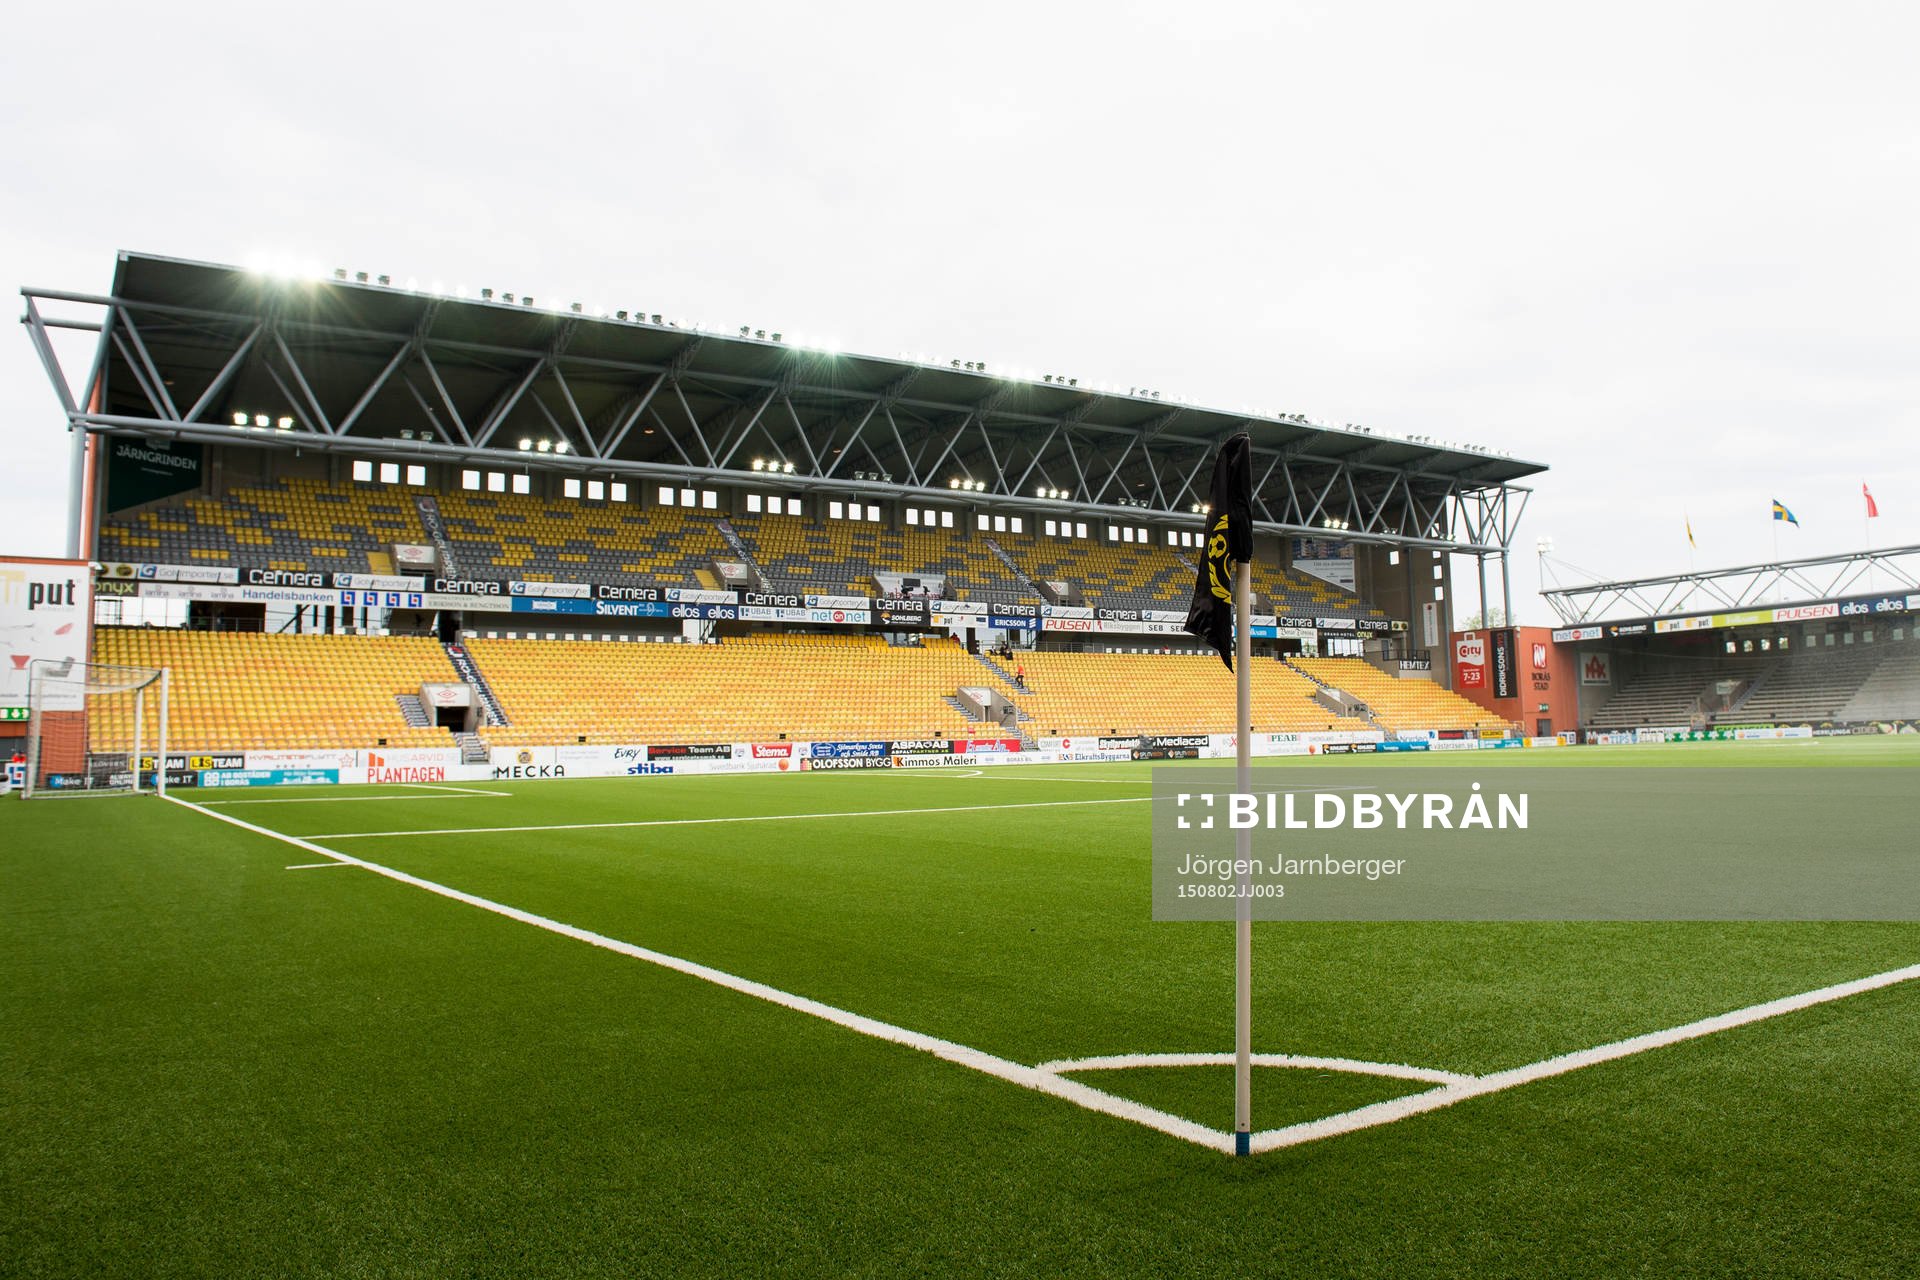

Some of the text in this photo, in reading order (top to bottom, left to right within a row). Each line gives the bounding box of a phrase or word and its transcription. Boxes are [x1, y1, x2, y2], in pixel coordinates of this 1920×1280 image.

[116, 444, 197, 470] JÄRNGRINDEN
[28, 580, 75, 610] put
[242, 589, 334, 602] Handelsbanken
[596, 603, 639, 616] SILVENT
[1842, 602, 1869, 615] ellos
[1875, 598, 1904, 612] ellos
[672, 605, 700, 618] ellos
[707, 607, 735, 619] ellos
[1777, 605, 1834, 620] PULSEN
[994, 619, 1026, 627] ERICSSON
[1045, 620, 1091, 631] PULSEN
[1400, 660, 1430, 670] HEMTEX
[1463, 671, 1481, 681] 7-23
[716, 745, 731, 753] AB
[932, 741, 949, 749] AB
[153, 758, 184, 769] TAM
[812, 758, 891, 768] OLOFSSON BYGG
[897, 757, 940, 767] Kimmos
[497, 764, 565, 778] MECKA
[627, 763, 673, 775] stiba
[368, 767, 445, 784] PLANTAGEN
